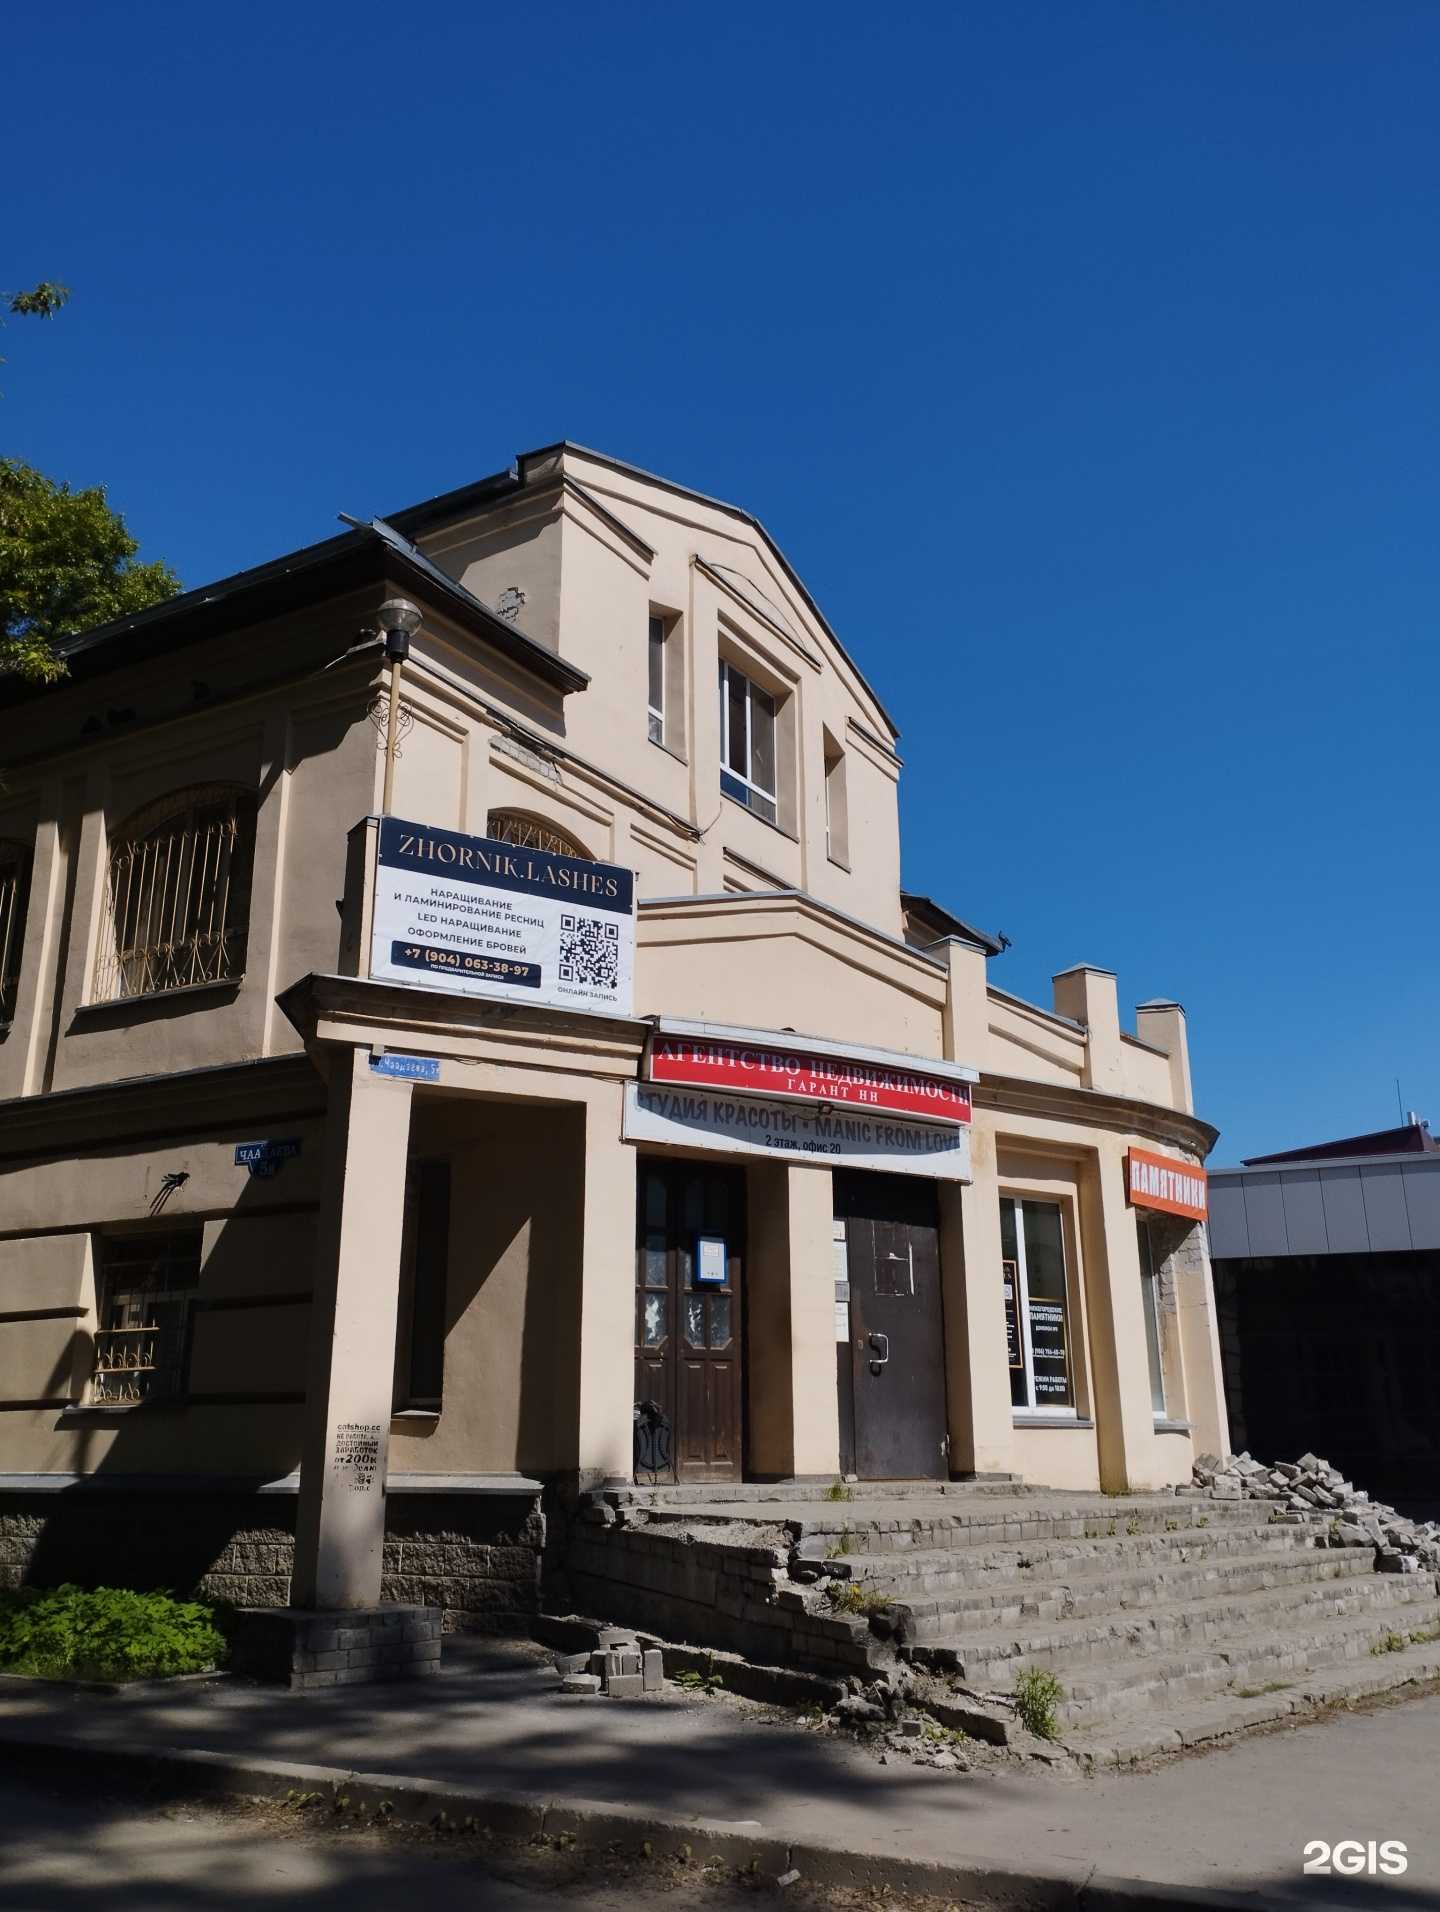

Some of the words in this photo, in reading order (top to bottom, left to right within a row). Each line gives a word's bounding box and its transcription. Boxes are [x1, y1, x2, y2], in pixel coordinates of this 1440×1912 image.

[399, 834, 618, 897] ZHORNIK.LASHES
[394, 893, 401, 901] И
[405, 895, 502, 919] ЛАМИНИРОВАНИЕ
[504, 913, 545, 928] РЕСНИЦ
[431, 888, 513, 910] НАРАЩИВАНИЕ
[417, 913, 437, 923] LED
[441, 917, 522, 938] НАРАЩИВАНИЕ
[408, 927, 483, 947] ОФОРМЛЕНИЕ
[486, 941, 526, 954] БРОВЕЙ
[404, 948, 421, 959] +7
[425, 949, 461, 966] (904)
[465, 957, 529, 977] 063-38-97
[557, 986, 588, 997] ОНЛАЙН
[590, 992, 618, 1001] ЗАПИСЬ
[657, 1042, 800, 1075] АГЕНТСТВО
[809, 1060, 969, 1106] НЕДВИЖИМОСТИ
[787, 1078, 849, 1098] ГАРАНТ
[859, 1092, 878, 1103] НН
[714, 1099, 797, 1133] КРАСОТЫ
[815, 1117, 872, 1143] MANIC
[876, 1125, 921, 1151] FROM
[766, 1134, 772, 1146] 2
[774, 1138, 800, 1151] этаж,
[803, 1140, 828, 1153] офис
[830, 1142, 841, 1154] 20
[1131, 1159, 1206, 1210] ПАМЯТНИКИ
